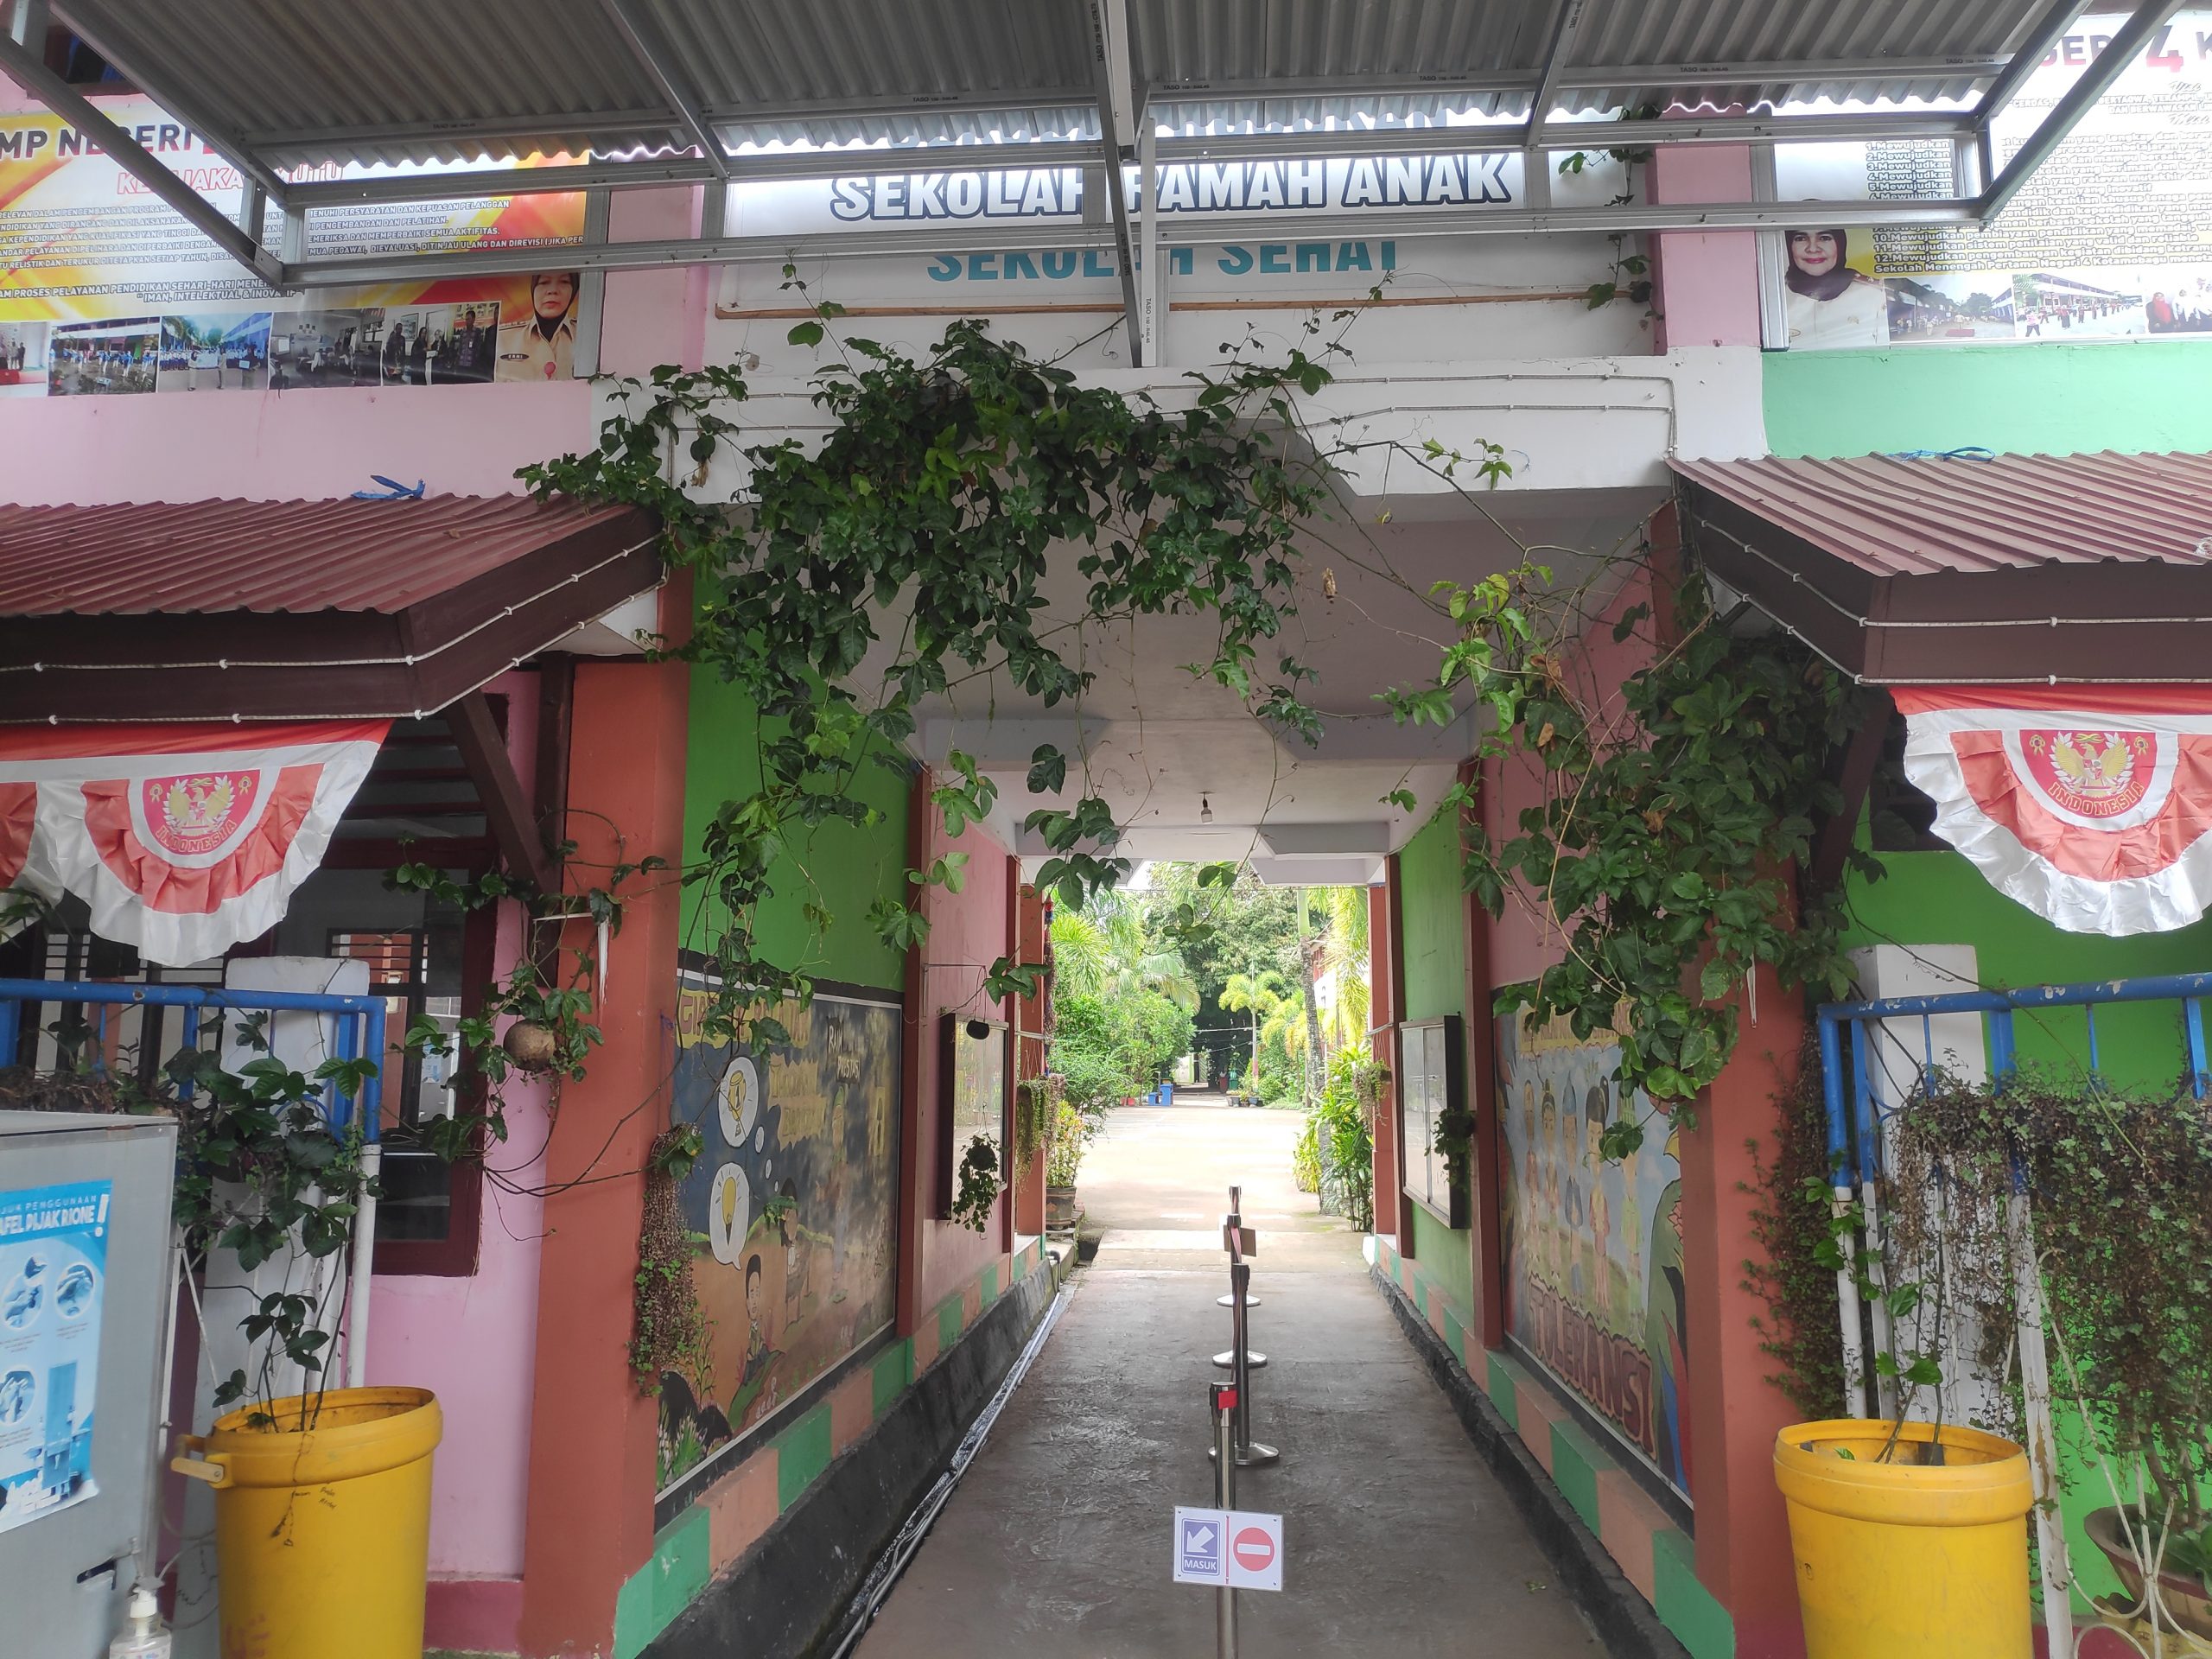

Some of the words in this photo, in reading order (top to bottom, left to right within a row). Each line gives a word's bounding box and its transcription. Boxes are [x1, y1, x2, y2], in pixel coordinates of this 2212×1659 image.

[2146, 24, 2184, 73] 4
[58, 124, 192, 157] NEERI
[1866, 140, 1949, 151] 1.Mewujudkan
[2075, 135, 2105, 144] yang
[2106, 132, 2153, 143] lengkap
[2155, 131, 2178, 141] dan
[1866, 150, 1950, 162] 2.Mewujudkan
[2055, 145, 2095, 156] proses
[2096, 142, 2178, 154] pembelajaran
[2069, 155, 2092, 164] dan
[2094, 154, 2139, 165] mampu
[2139, 151, 2192, 162] bersaing
[1866, 161, 1951, 172] 3.Mewujudkan
[2072, 165, 2101, 175] yang
[2102, 162, 2154, 173] beriman
[2154, 162, 2177, 171] dan
[1341, 153, 1512, 207] ANAK
[1867, 171, 1952, 182] 4.Mewujudkan
[2052, 176, 2081, 187] yang
[2082, 174, 2127, 184] relevan
[2129, 172, 2186, 182] mutakhir
[1868, 181, 1953, 192] 5.Mewujudkan
[2075, 186, 2106, 196] yang
[2107, 183, 2153, 194] inovatif
[2048, 194, 2099, 206] keahlian
[2100, 194, 2145, 204] khusus
[2145, 193, 2187, 204] tenaga
[339, 206, 397, 217] PERSYARATAN
[416, 203, 459, 213] KEPUASAN
[460, 200, 510, 211] PELANGGAN
[2052, 207, 2075, 216] dan
[2076, 204, 2157, 216] kependidikan
[2158, 203, 2187, 213] yang
[2028, 216, 2081, 227] berbasis
[2082, 215, 2129, 226] sekolah
[2130, 215, 2159, 225] yang
[2161, 213, 2210, 223] tangguh
[9, 234, 67, 244] KEPENDIDIKAN
[315, 221, 382, 231] PENGEMBANGAN
[383, 219, 400, 227] DAN
[401, 216, 448, 226] PELATIHAN.
[1872, 232, 1965, 245] 10.Mewujudkan
[1967, 229, 2037, 243] pembiayaan
[2038, 226, 2104, 238] pendidikan
[2106, 226, 2135, 237] yang
[2137, 223, 2196, 234] memadai,
[24, 245, 70, 256] PELAYANAN
[138, 241, 184, 251] DIPERBAIKI
[308, 233, 347, 243] EMERIKSA
[368, 230, 424, 240] MEMPERBAIKI
[425, 228, 455, 238] SEMUA
[1873, 241, 1967, 254] 11.Mewujudkan
[1967, 240, 2006, 250] sistem
[2008, 238, 2063, 250] penilaian
[2064, 238, 2094, 248] yang
[2094, 235, 2125, 245] valid
[2127, 234, 2150, 245] dan
[2151, 232, 2199, 244] reliable
[10, 260, 43, 270] RELISTIK
[45, 259, 61, 268] DAN
[151, 254, 180, 263] SETIAP
[328, 245, 368, 256] PEGAWAI,
[371, 243, 420, 253] DIEVALUASI,
[421, 241, 460, 251] DITINJAU
[461, 241, 488, 250] ULANG
[509, 238, 543, 247] DIREVISI
[544, 236, 566, 246] (JIKA
[1874, 251, 1967, 264] 12.Mewujudkan
[1968, 248, 2059, 262] pengembangan
[2060, 246, 2112, 258] kegiatan
[2113, 245, 2164, 256] dibidang
[926, 248, 1193, 282] SEKOLH
[1873, 264, 1923, 274] Sekolah
[1924, 261, 1985, 272] Menengah
[1986, 258, 2038, 270] Pertama
[2040, 258, 2081, 270] Negeri
[2082, 257, 2091, 267] 4
[2093, 255, 2167, 267] Kotamobagu
[14, 287, 51, 298] PROSES
[52, 284, 110, 296] PELAYANAN
[111, 282, 170, 294] PENDIDIKAN
[171, 279, 236, 292] SEHARI-HARI
[174, 290, 240, 302] INTELEKTUAL
[241, 290, 251, 299] &
[2047, 781, 2145, 817] INDONESIA
[156, 819, 238, 853] INDONESIA
[25, 1195, 97, 1211] PENGGUNAAN
[25, 1211, 60, 1231] PIJAK
[60, 1205, 95, 1226] RIONE
[1530, 1284, 1654, 1453] TOLERANSI
[1184, 1559, 1217, 1571] MASUK
